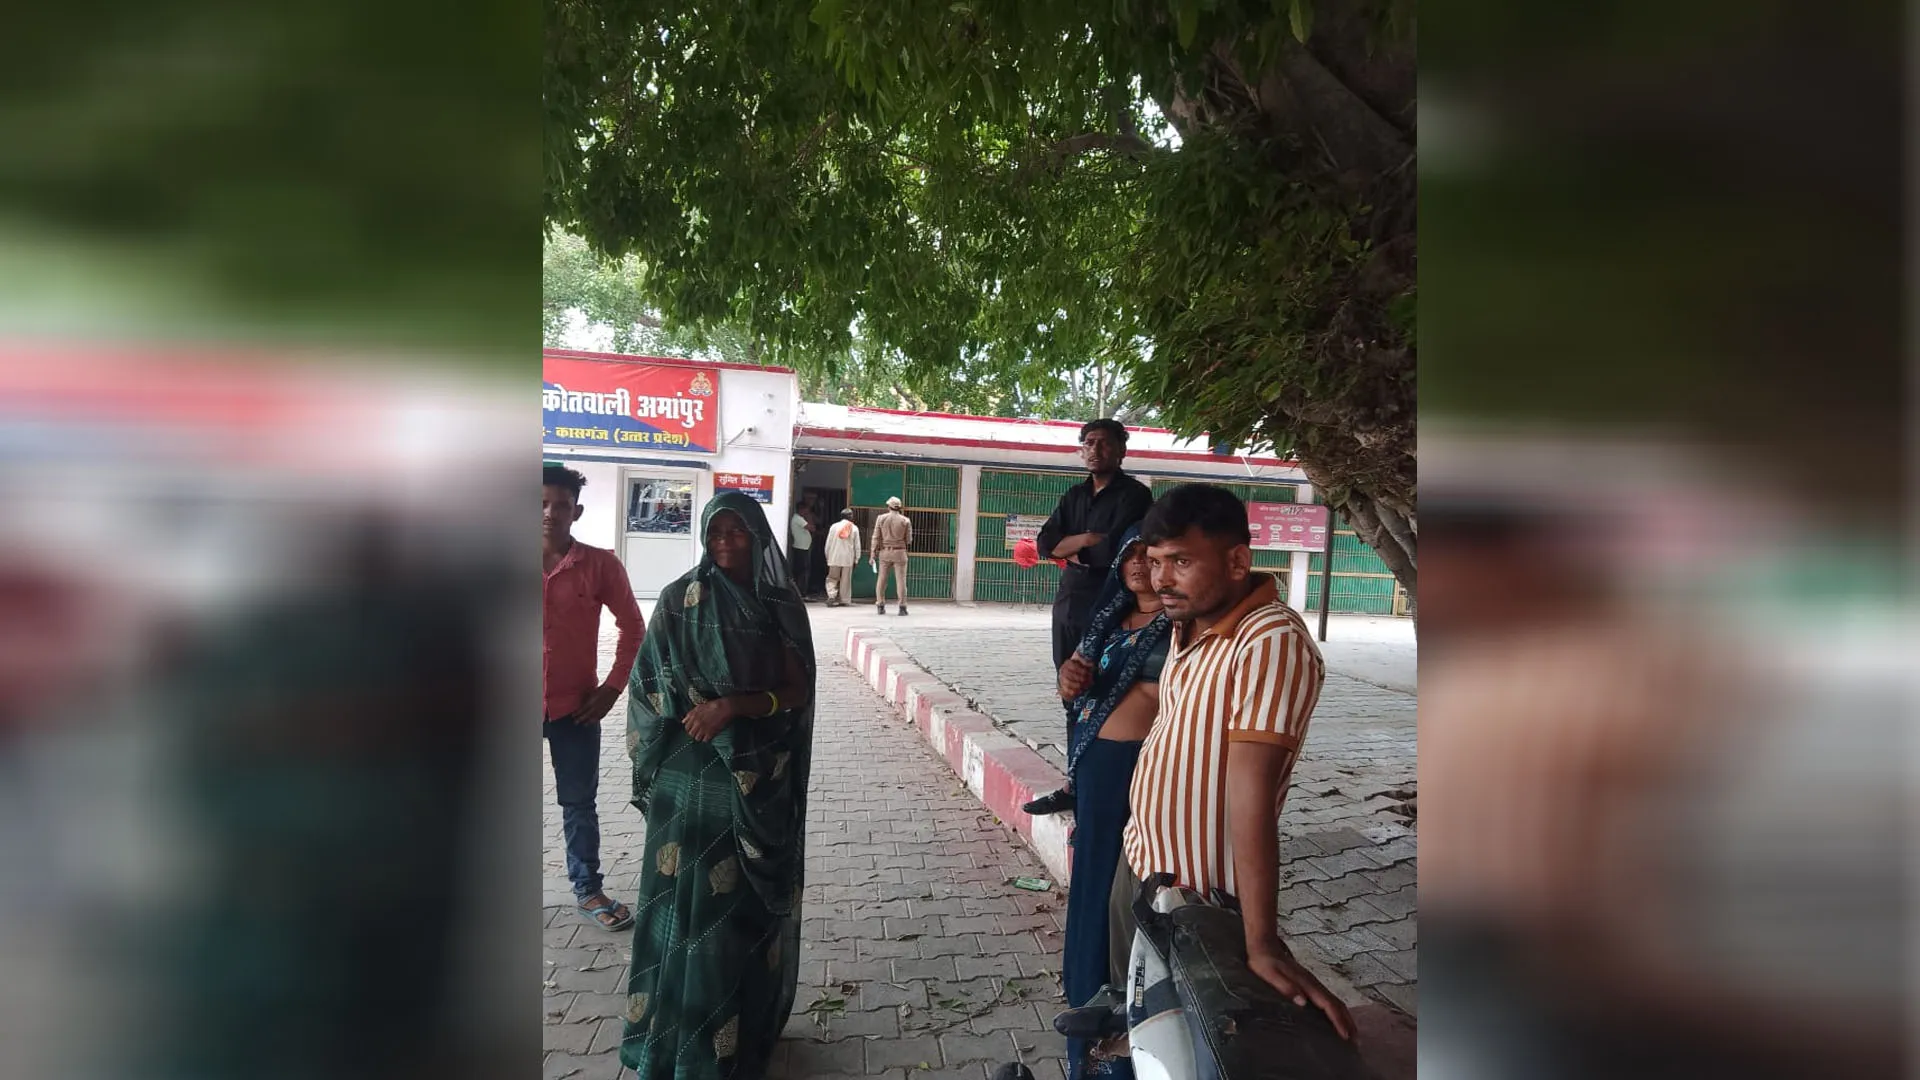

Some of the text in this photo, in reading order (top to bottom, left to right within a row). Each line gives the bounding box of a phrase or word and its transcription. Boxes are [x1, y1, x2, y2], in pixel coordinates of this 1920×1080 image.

[543, 383, 704, 428] कोतवाली अमांपुर
[555, 426, 609, 440] कासगंज
